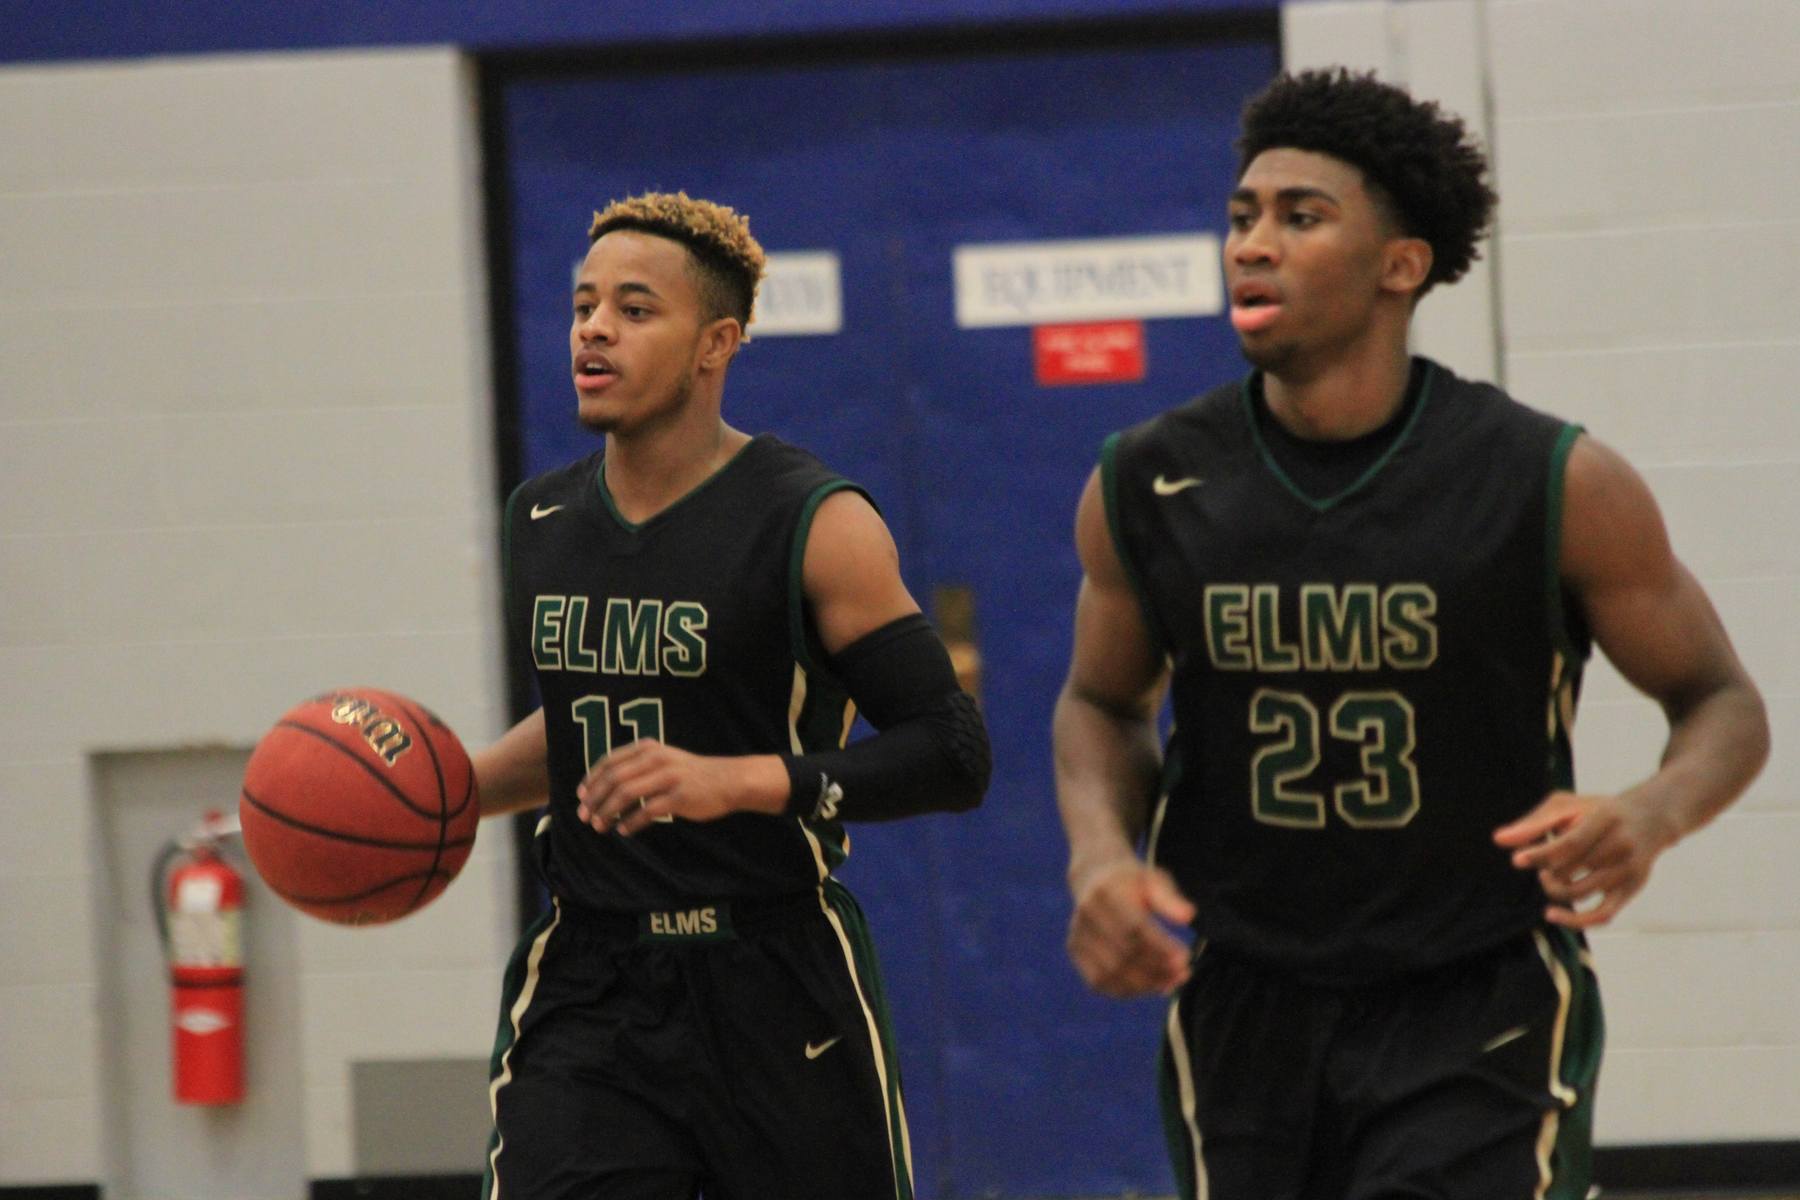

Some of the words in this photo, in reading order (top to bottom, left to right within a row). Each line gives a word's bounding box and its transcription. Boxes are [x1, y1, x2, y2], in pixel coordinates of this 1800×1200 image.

[982, 257, 1191, 311] EQUIPMENT
[531, 595, 708, 677] ELMS
[1203, 583, 1438, 672] ELMS
[1250, 688, 1420, 829] 23
[650, 907, 717, 934] ELMS
